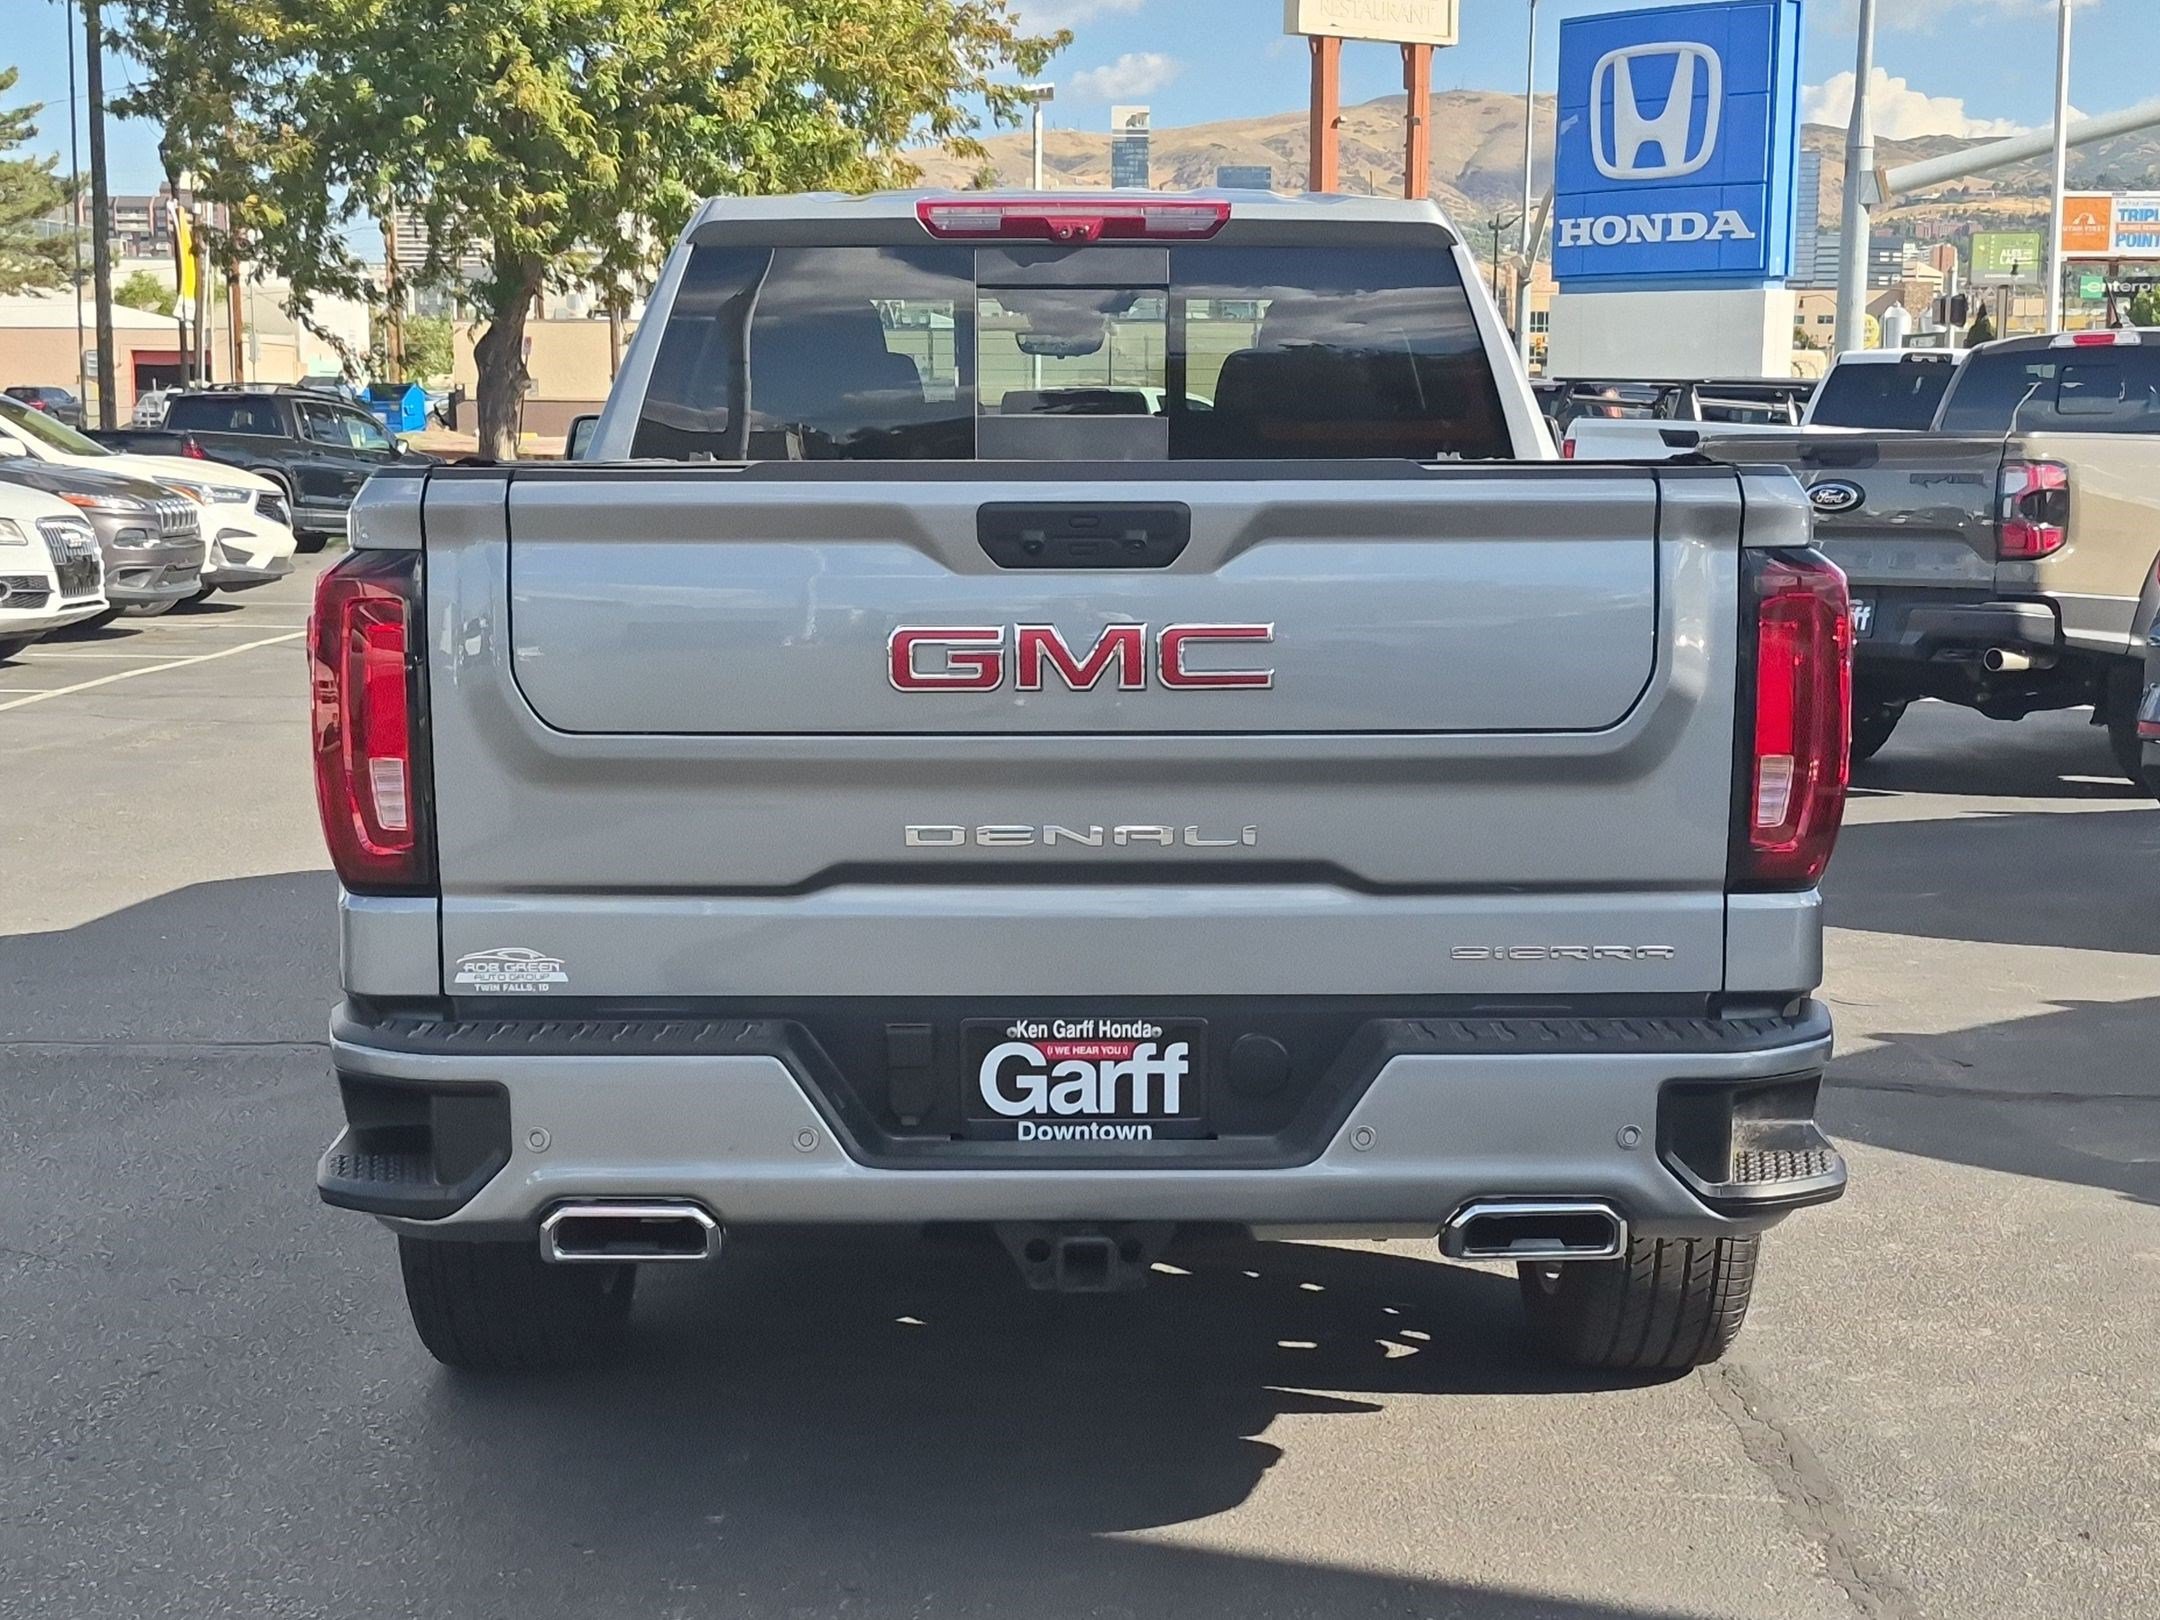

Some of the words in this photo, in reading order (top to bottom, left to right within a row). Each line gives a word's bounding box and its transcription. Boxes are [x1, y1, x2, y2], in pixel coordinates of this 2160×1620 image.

[1558, 210, 1755, 247] HONDA
[1816, 489, 1845, 503] Ford
[886, 622, 1275, 692] GMC
[904, 825, 1258, 847] DENALI
[1451, 945, 1675, 960] SIERRA
[463, 962, 499, 972] ROB
[504, 962, 560, 972] GREEN
[474, 973, 506, 981] AUTO
[509, 973, 550, 981] GROUP
[474, 983, 500, 992] TWIN
[538, 983, 549, 992] ID
[1016, 1020, 1048, 1038] Ken
[1053, 1020, 1094, 1038] Garff
[1098, 1020, 1151, 1039] Honda
[1054, 1046, 1070, 1055] WE
[1072, 1046, 1099, 1055] HEAR
[1101, 1046, 1121, 1055] YOU
[979, 1041, 1189, 1117] Garff
[1018, 1121, 1152, 1141] Downtown
